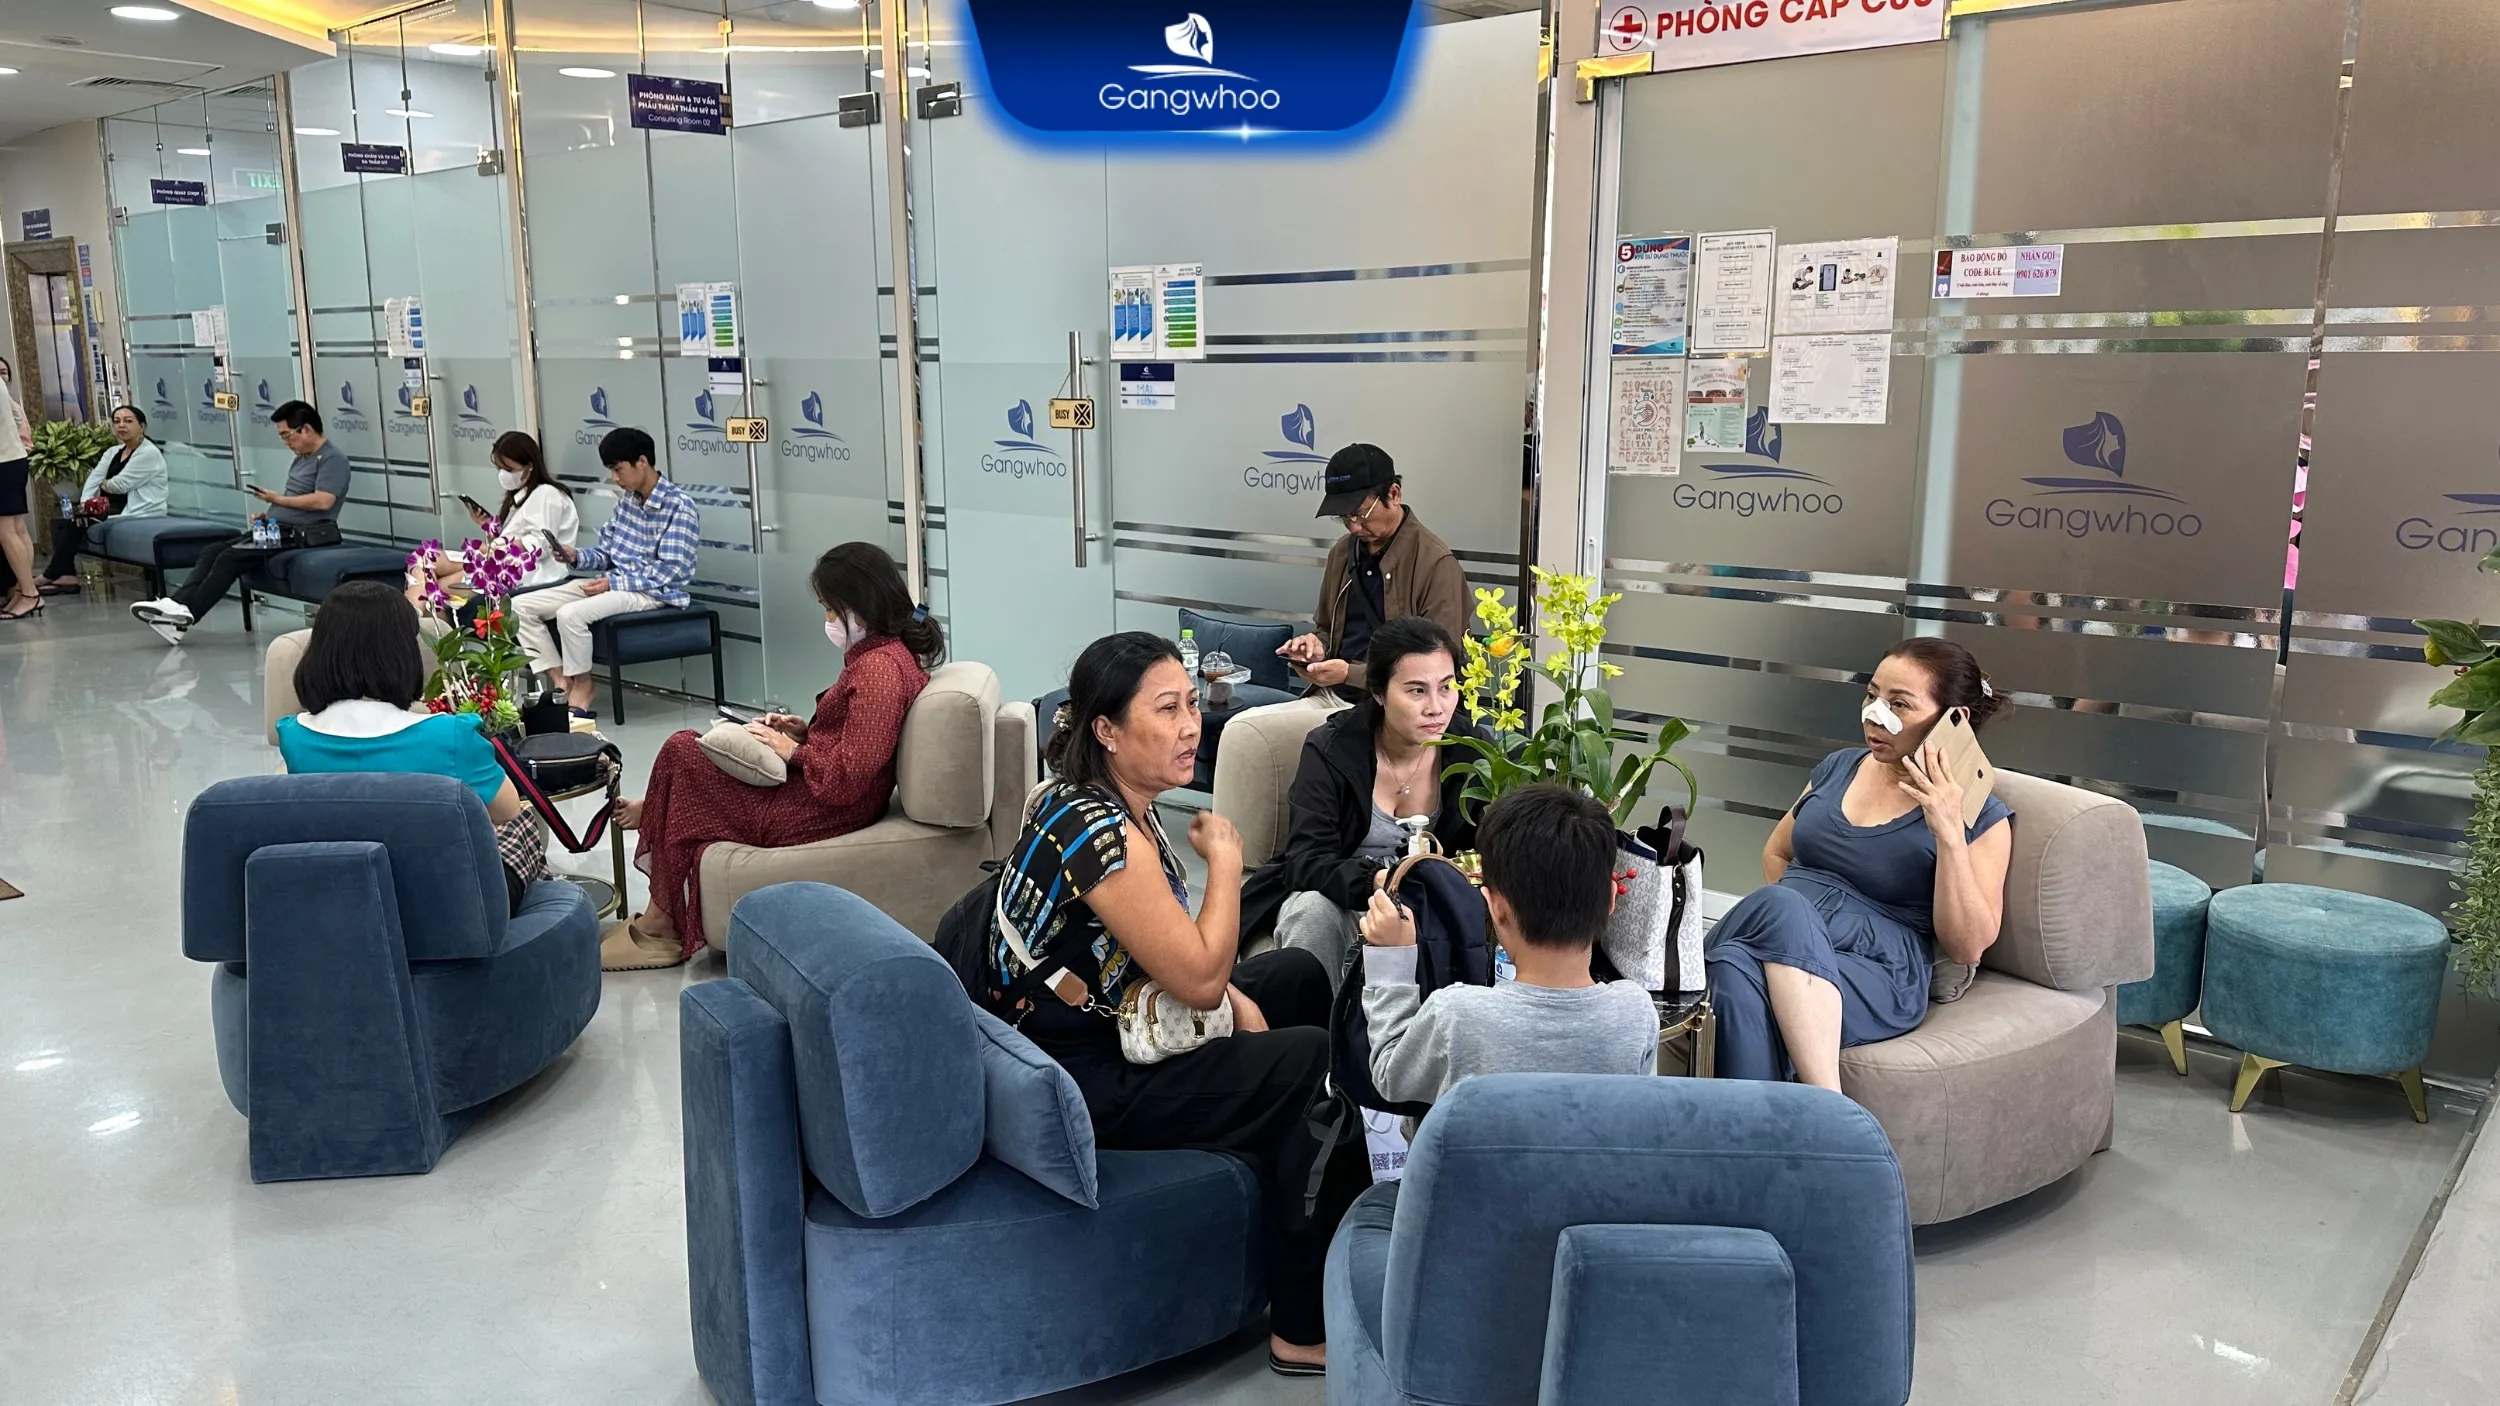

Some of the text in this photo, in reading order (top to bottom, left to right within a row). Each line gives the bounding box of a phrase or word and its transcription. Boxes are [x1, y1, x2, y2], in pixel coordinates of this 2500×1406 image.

[1657, 0, 1769, 39] PHÒNG
[639, 91, 664, 100] PHÒNG
[665, 94, 686, 103] KHÁM
[702, 96, 716, 105] VẤN
[658, 102, 679, 113] THUẬT
[648, 113, 711, 127] Consulting Room 02
[1621, 245, 1632, 260] 5
[1670, 250, 1689, 259] THUỐC
[2041, 250, 2056, 262] GỌI
[1963, 267, 2003, 277] CODE BLUE
[2016, 268, 2057, 279] 0901 626 879
[1055, 409, 1070, 419] BUSY
[332, 418, 368, 432] Gangwhoo
[388, 420, 427, 436] Gangwhoo
[732, 426, 745, 435] BUSY
[452, 424, 496, 442] Gangwhoo
[677, 435, 739, 456] Gangwhoo
[781, 440, 850, 463] Gangwhoo
[981, 453, 1067, 479] Gangwhoo
[1244, 467, 1326, 495] Gangwh
[1673, 483, 1843, 518] Gangwhoo
[1985, 498, 2202, 538] Gangwhoo
